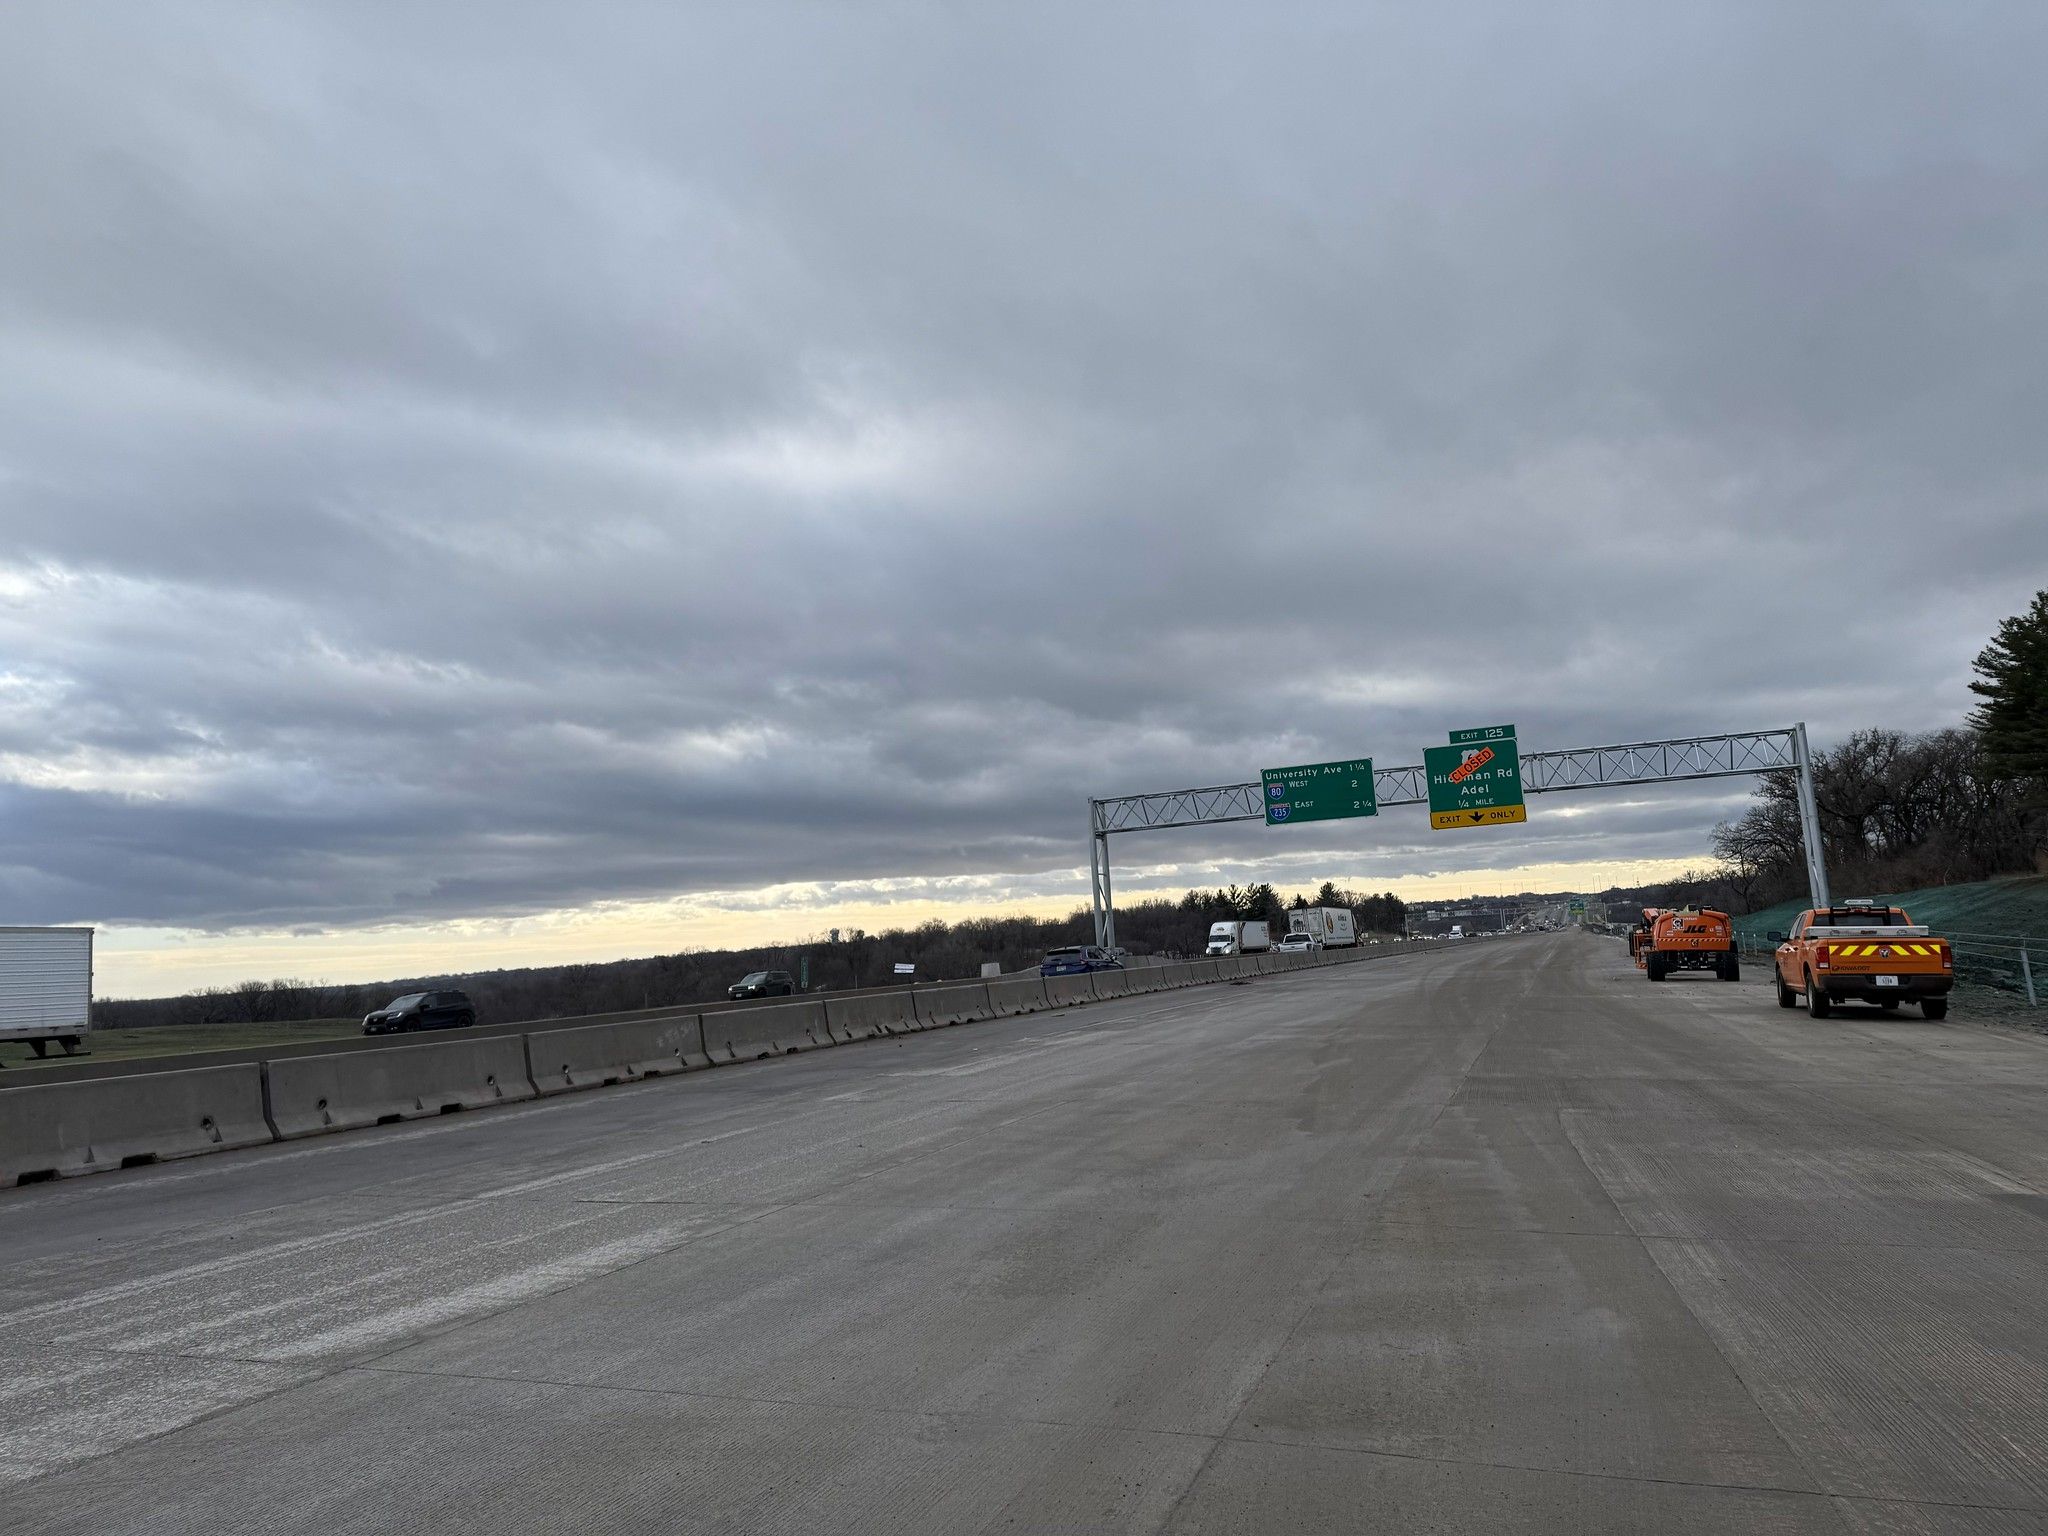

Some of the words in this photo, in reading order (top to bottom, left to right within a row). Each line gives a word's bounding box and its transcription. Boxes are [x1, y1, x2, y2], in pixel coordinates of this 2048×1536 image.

[1460, 732, 1478, 740] EXIT
[1485, 728, 1504, 738] 125
[1451, 749, 1492, 782] CLOSED
[1266, 769, 1317, 779] University
[1434, 772, 1490, 784] Hicman
[1497, 768, 1513, 778] Rd
[1271, 788, 1281, 796] 80
[1461, 784, 1489, 795] Adel
[1475, 798, 1494, 806] MILE
[1274, 808, 1287, 816] 235
[1440, 815, 1461, 824] EXIT
[1490, 810, 1516, 819] ONLY
[1683, 925, 1707, 933] JLG
